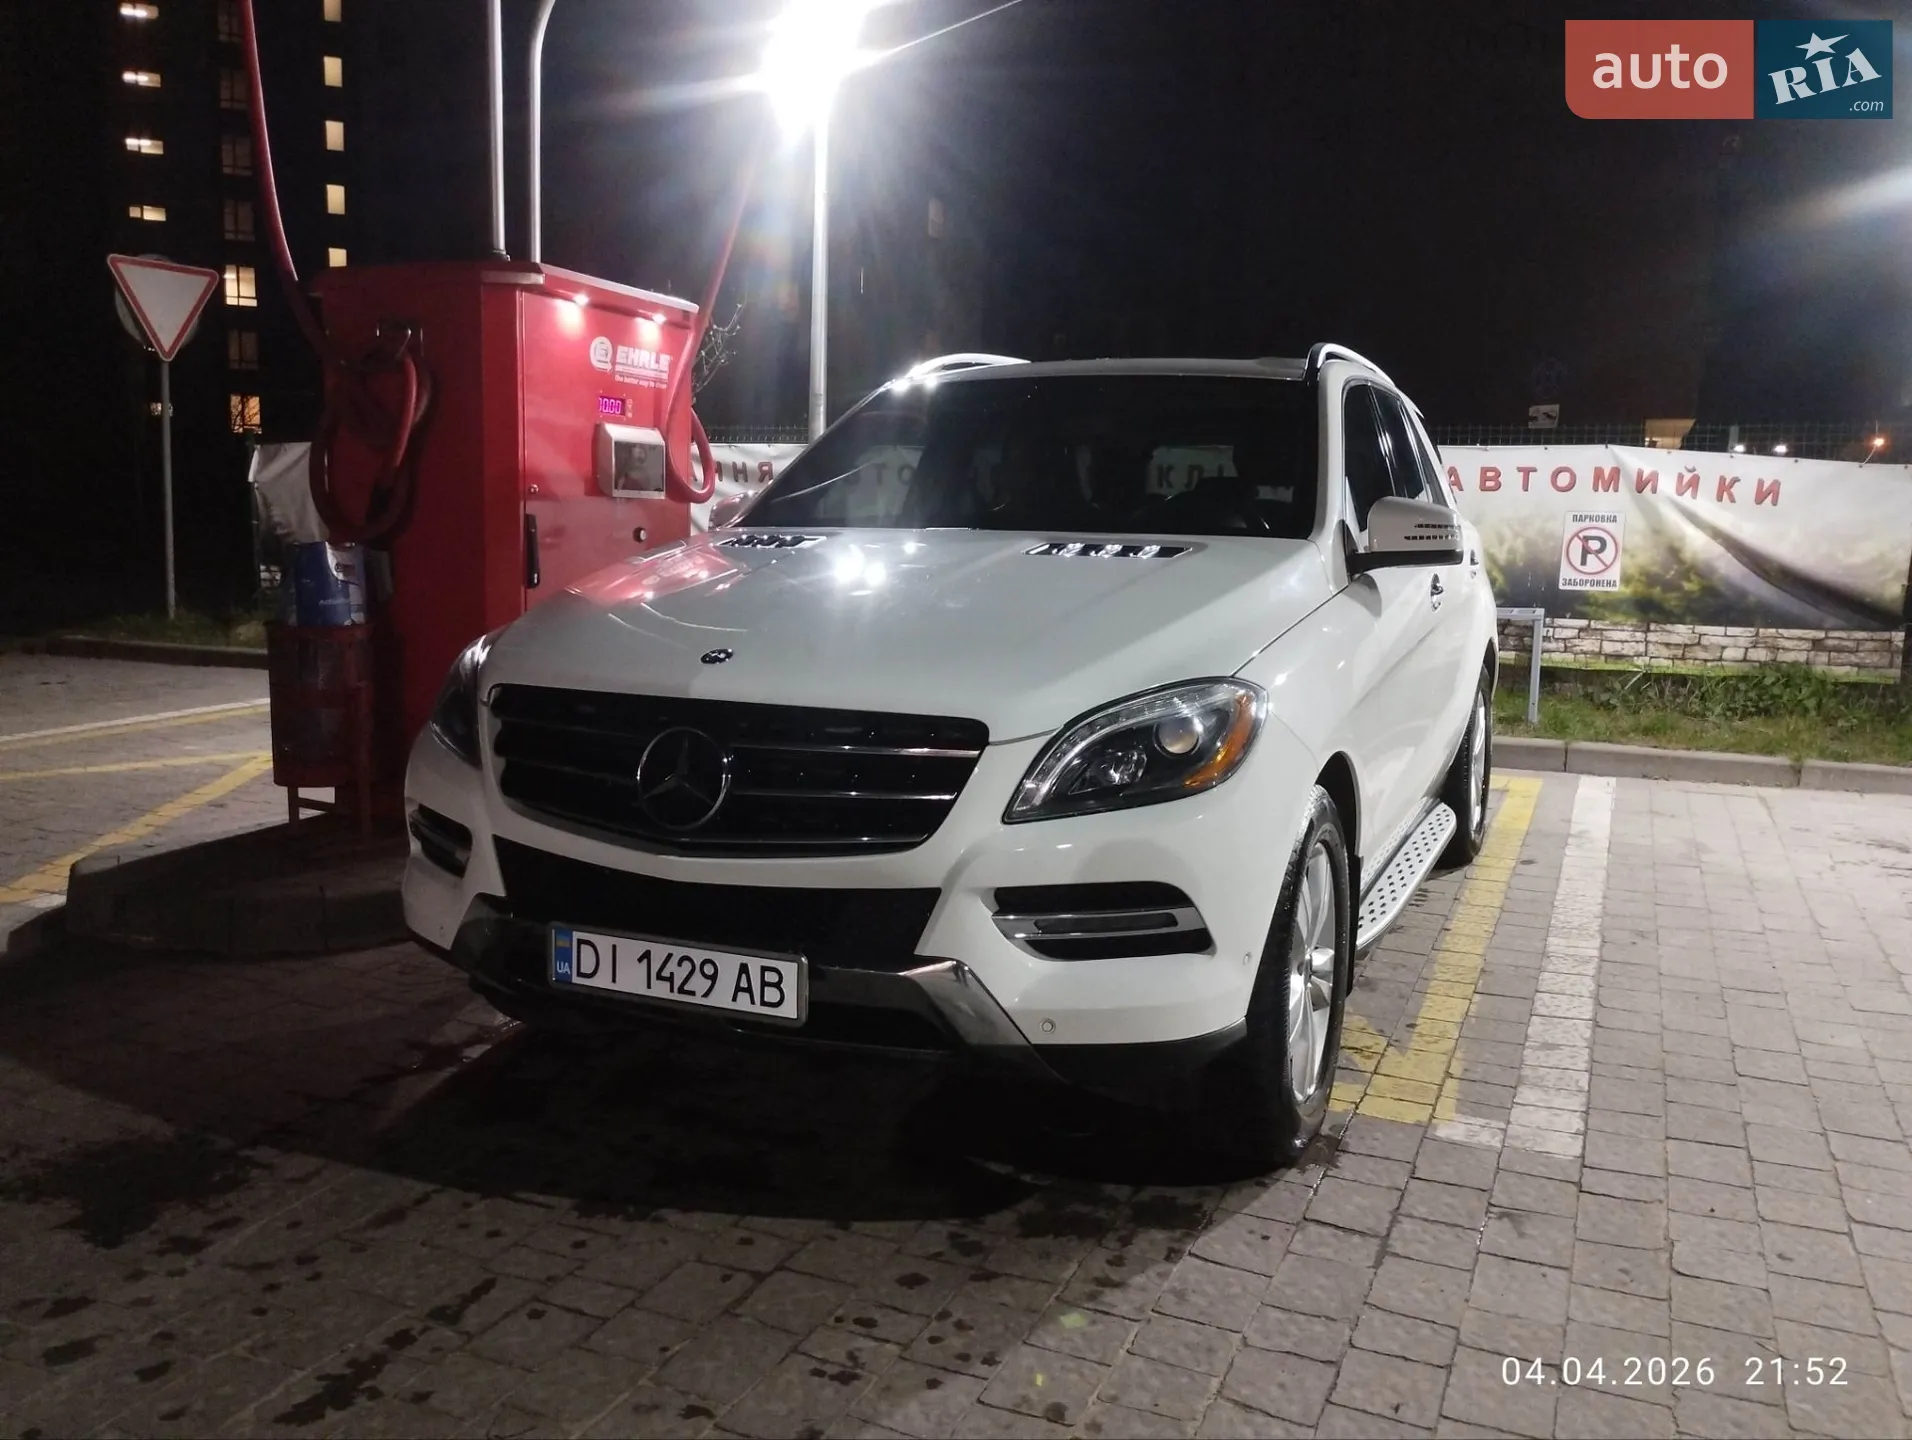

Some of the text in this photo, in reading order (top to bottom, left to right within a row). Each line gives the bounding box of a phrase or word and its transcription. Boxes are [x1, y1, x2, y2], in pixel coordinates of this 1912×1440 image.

[1447, 465, 1782, 506] АВТОМИЙКИ
[1572, 514, 1617, 523] ПАРКОВКА
[1562, 578, 1617, 588] ЗАБОРОНЕНА
[556, 938, 785, 1009] UA DI 1429 AB
